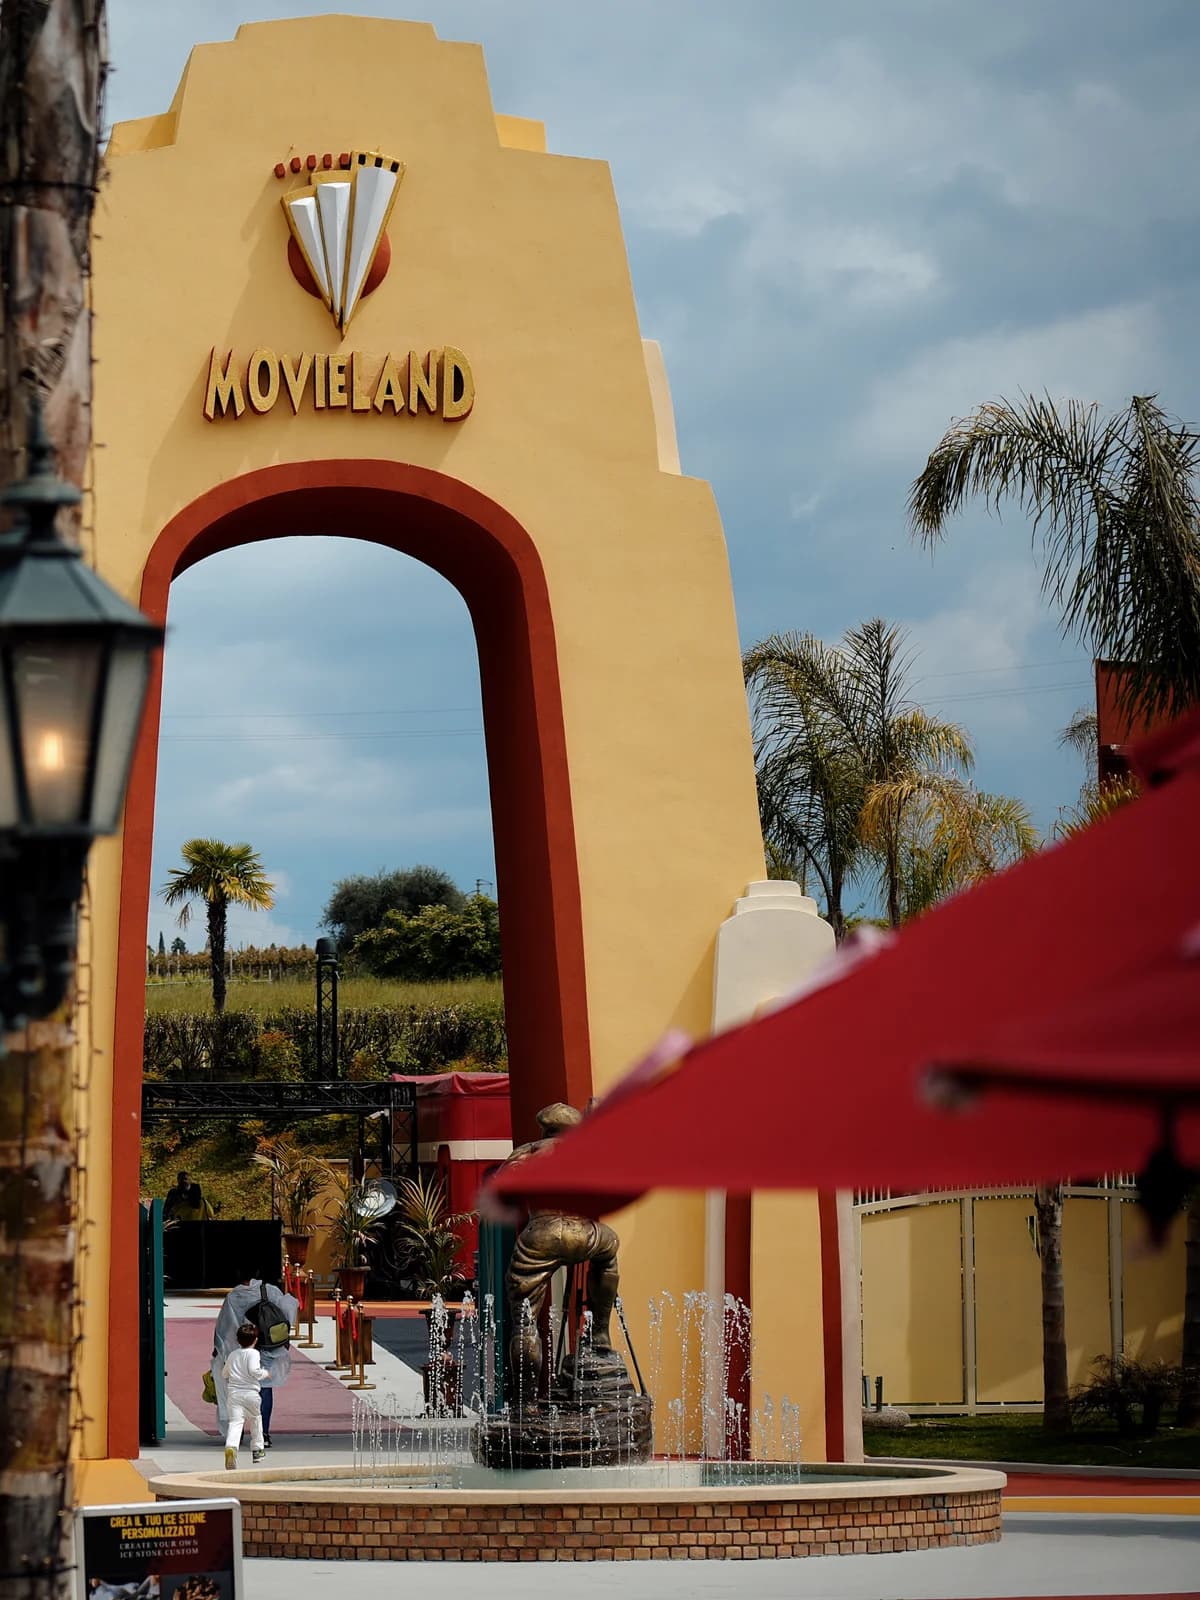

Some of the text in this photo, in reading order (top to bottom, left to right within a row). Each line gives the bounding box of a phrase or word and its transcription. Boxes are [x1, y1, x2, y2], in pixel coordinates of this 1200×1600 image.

[202, 345, 476, 422] MOVIELAND
[110, 1512, 207, 1528] CREA IL TUO ICE STONE
[121, 1525, 196, 1540] PERSONALIZZATO
[119, 1539, 199, 1550] CREATE YOUR OWN
[120, 1547, 199, 1559] ICE STONE CUSTOM
